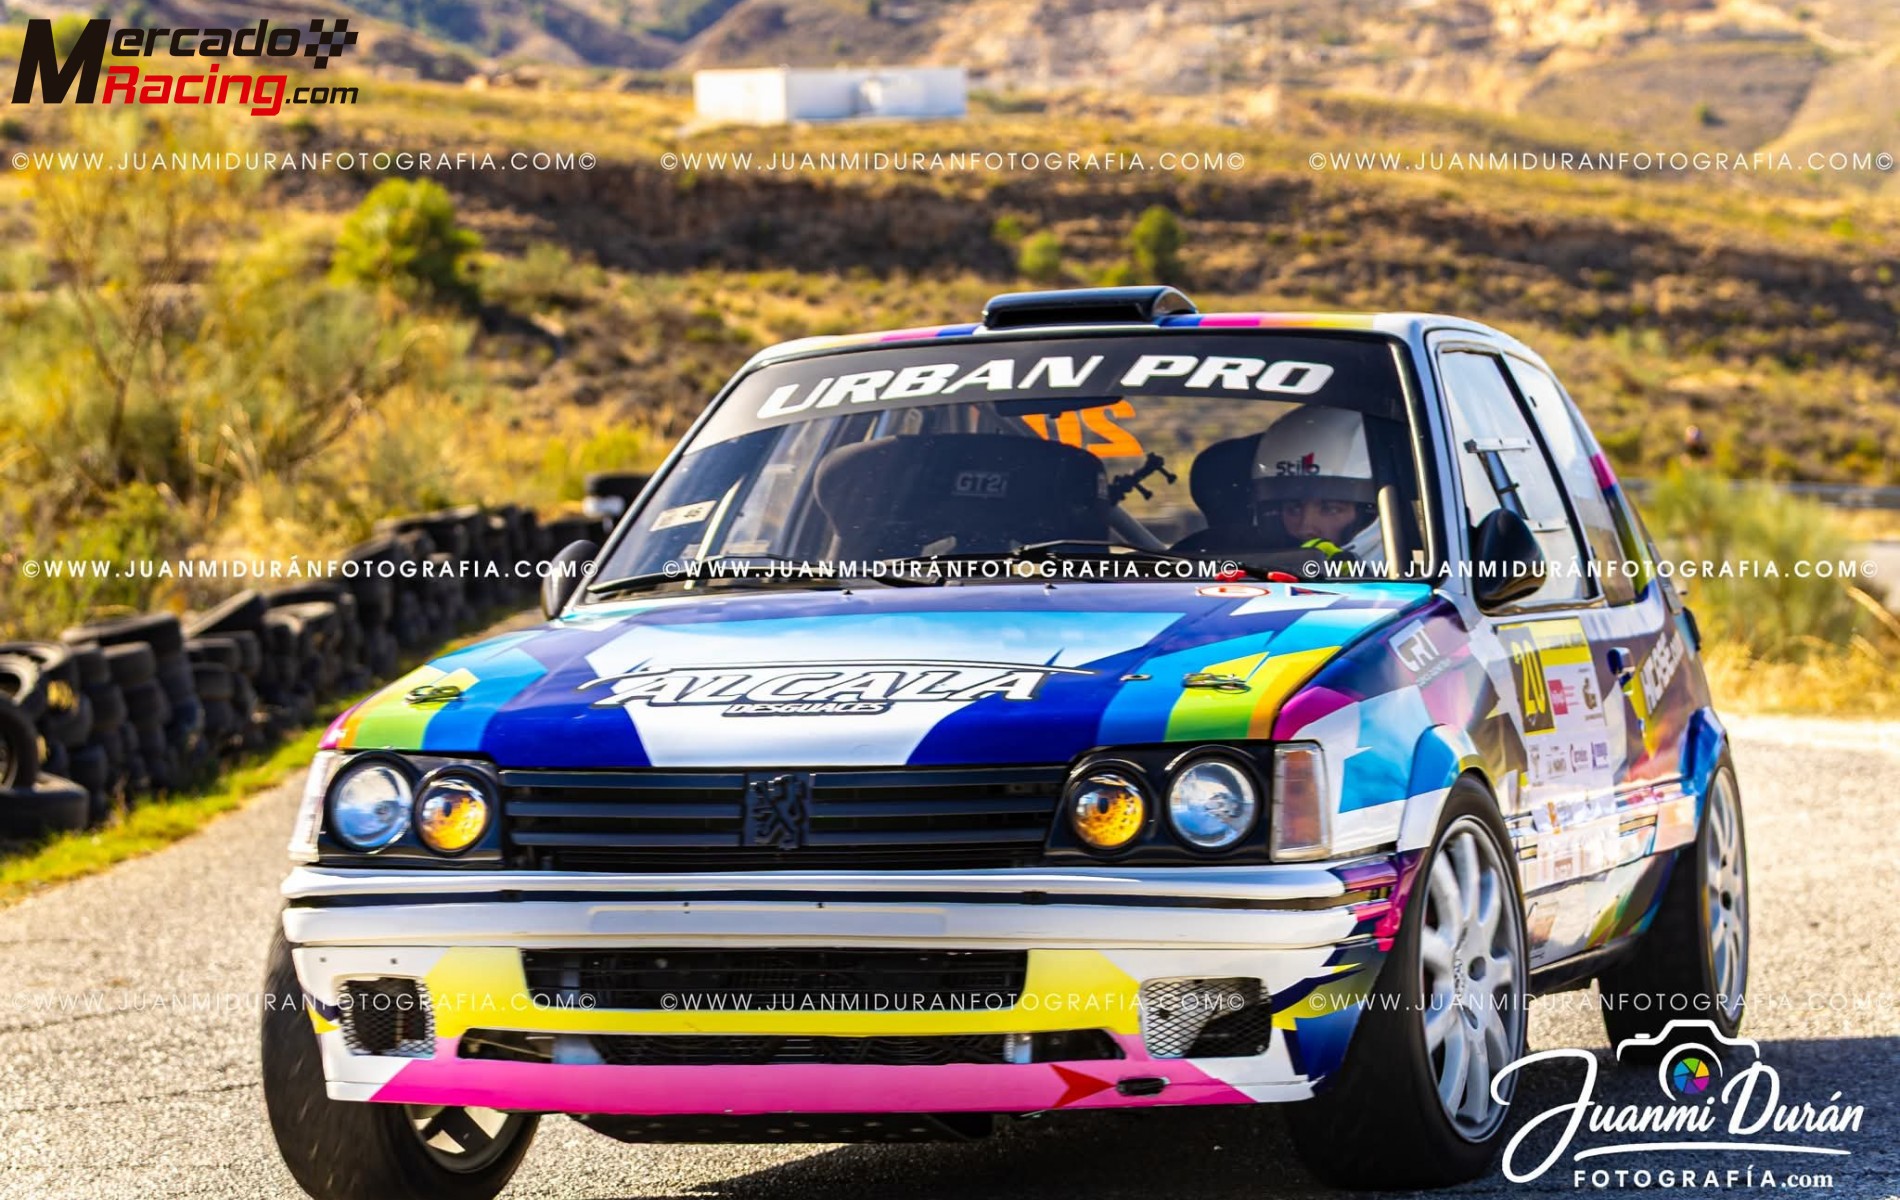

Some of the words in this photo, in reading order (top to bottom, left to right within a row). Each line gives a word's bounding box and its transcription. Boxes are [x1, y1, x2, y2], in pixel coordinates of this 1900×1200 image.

[757, 355, 1103, 419] URBAN
[1120, 354, 1334, 395] PRO
[592, 669, 1047, 708] ALCALA
[1511, 639, 1547, 715] 20
[724, 701, 889, 715] DESGUACES
